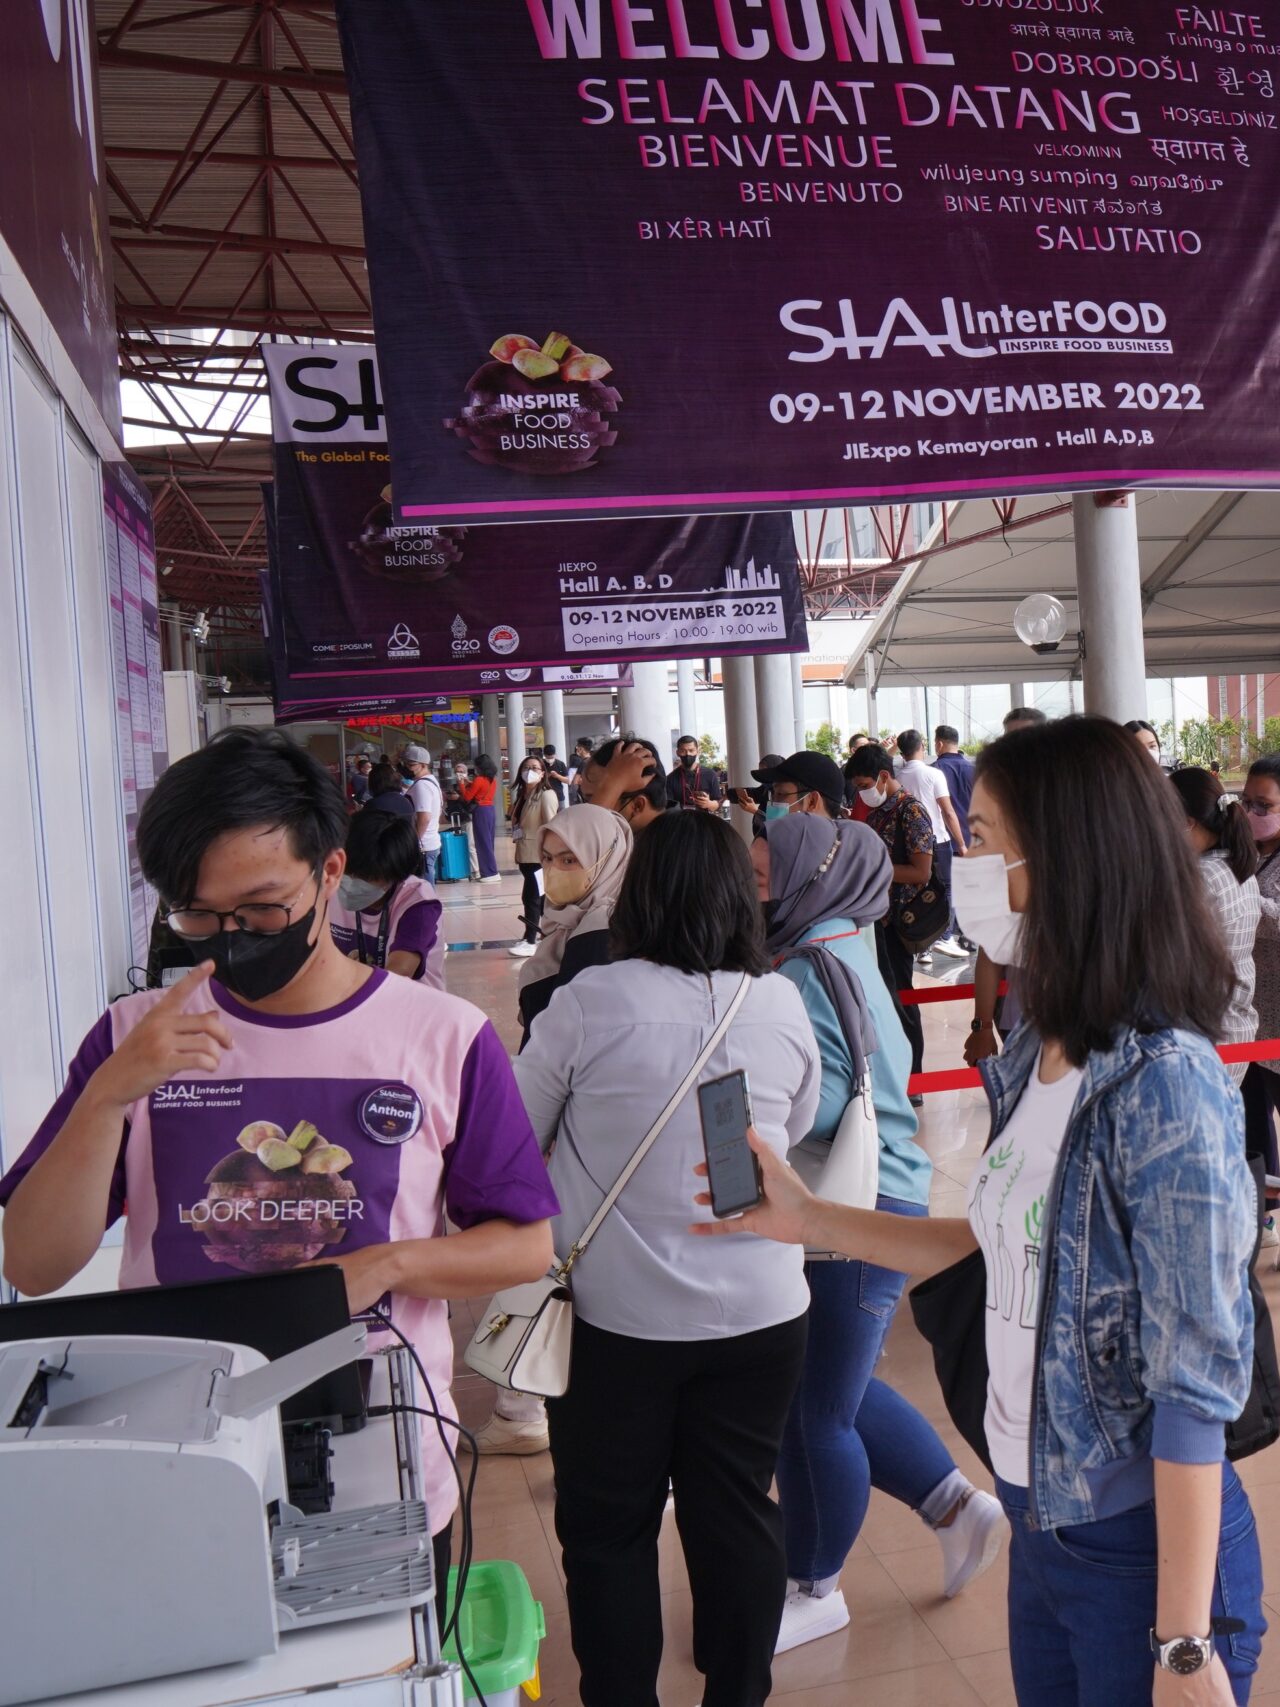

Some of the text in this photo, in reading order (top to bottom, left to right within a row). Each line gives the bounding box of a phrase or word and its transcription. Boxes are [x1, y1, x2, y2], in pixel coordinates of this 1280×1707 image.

[1174, 4, 1266, 39] FÀILTE
[525, 0, 956, 66] WELCOME
[1166, 31, 1232, 55] Tuhinga
[1236, 42, 1246, 53] o
[1011, 50, 1199, 83] DOBRODOŠLI
[576, 78, 1142, 136] SELAMAT DATANG
[638, 134, 898, 169] BIENVENUE
[1033, 143, 1122, 159] VELKOMINN
[920, 162, 1118, 190] wilujeung sumping
[739, 181, 903, 204] BENVENUTO
[944, 195, 1088, 216] BINE ATI VENIT
[638, 216, 772, 241] BI XÊR HATÎ
[1035, 223, 1202, 255] SALUTATIO
[778, 296, 1168, 363] SIAL InterFOOD
[1004, 340, 1171, 354] INSPIRE FOOD BUSINESS
[499, 392, 581, 410] INSPIRE
[769, 382, 1205, 425] 09-12 NOVEMBER 2022
[513, 413, 572, 430] FOOD
[500, 433, 591, 451] BUSINESS
[843, 441, 912, 462] JIExpo
[918, 435, 1039, 458] Kemayoran
[1056, 427, 1097, 447] Hall
[1102, 427, 1155, 447] A,D,B
[295, 450, 318, 462] The
[321, 450, 365, 462] Global
[385, 526, 440, 538] INSPIRE
[394, 540, 433, 551] FOOD
[384, 553, 445, 566] BUSINESS
[558, 561, 597, 573] JIEXPO
[560, 575, 599, 593] Hall
[660, 574, 673, 588] D
[569, 601, 777, 626] 09-12 NOVEMBER 2022
[451, 639, 480, 651] G20
[572, 631, 624, 648] Opening
[627, 630, 661, 642] Hours
[673, 625, 708, 640] 10.00
[719, 623, 754, 637] 19.00
[757, 622, 779, 635] wib
[480, 670, 500, 679] G20
[154, 1083, 243, 1101] SIAL Interfood
[153, 1101, 181, 1109] INSPIRE
[206, 1099, 241, 1107] BUSINESS
[178, 1199, 365, 1224] LOOK DEEPER
